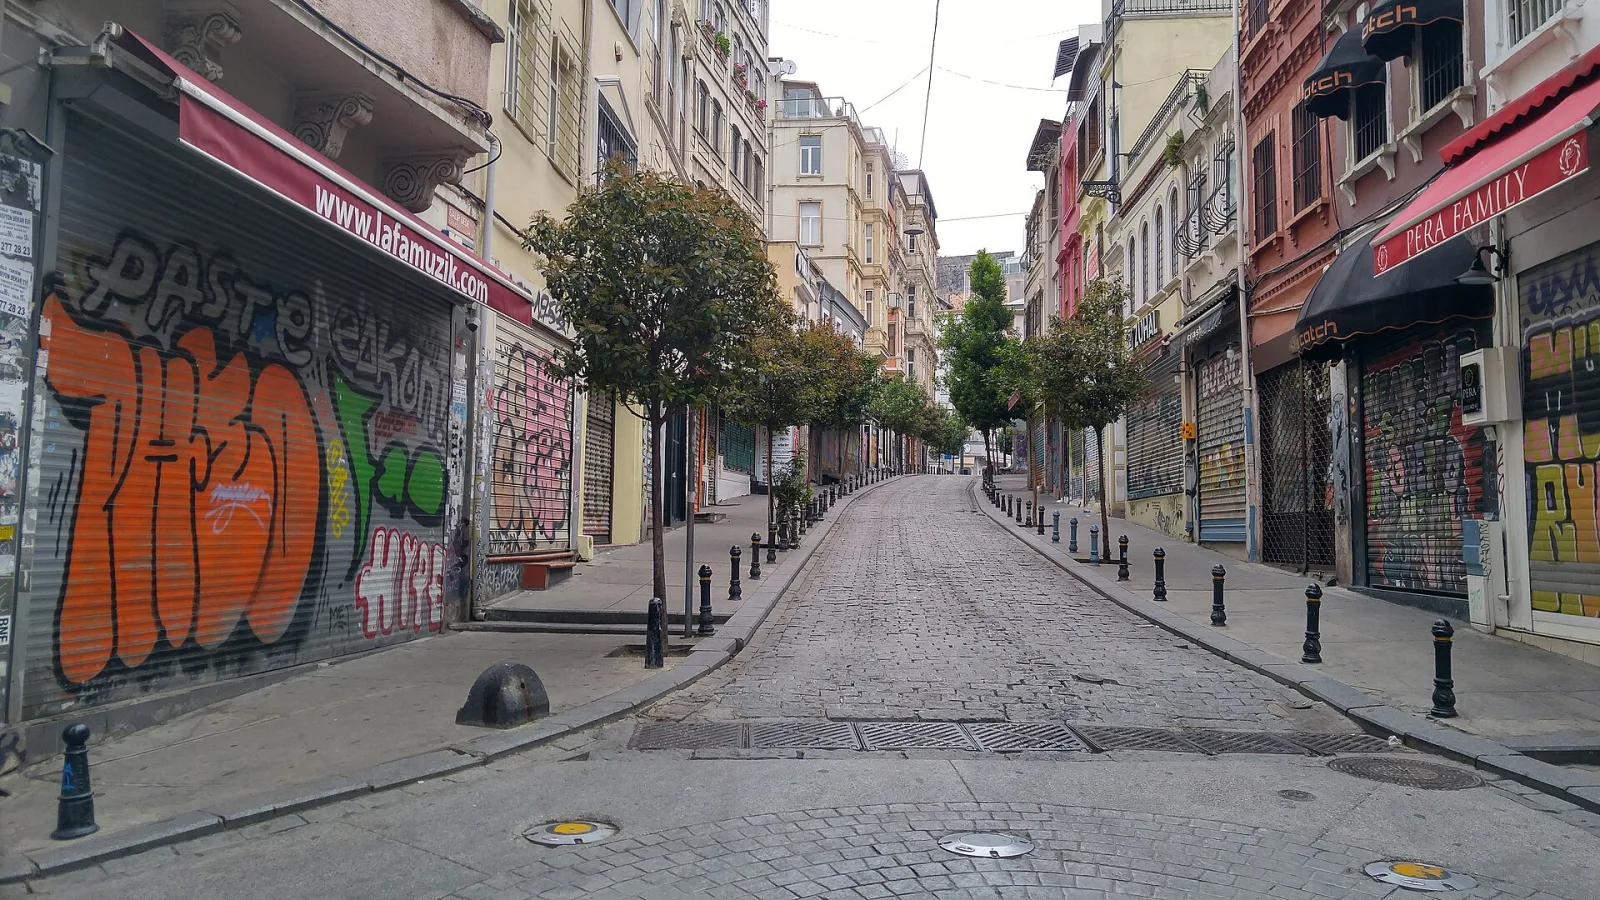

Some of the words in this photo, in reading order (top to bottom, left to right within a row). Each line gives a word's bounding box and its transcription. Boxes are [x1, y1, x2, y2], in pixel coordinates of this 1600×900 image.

[1406, 213, 1447, 258] PERA
[1453, 163, 1530, 234] FAMILY
[1, 241, 12, 252] 277
[14, 244, 22, 254] 28
[23, 246, 31, 256] 23
[315, 184, 489, 304] www.lafamuzik.com
[8, 303, 16, 313] 28
[17, 306, 26, 316] 23
[1131, 309, 1158, 348] ZUHAL
[1462, 387, 1477, 399] PERA
